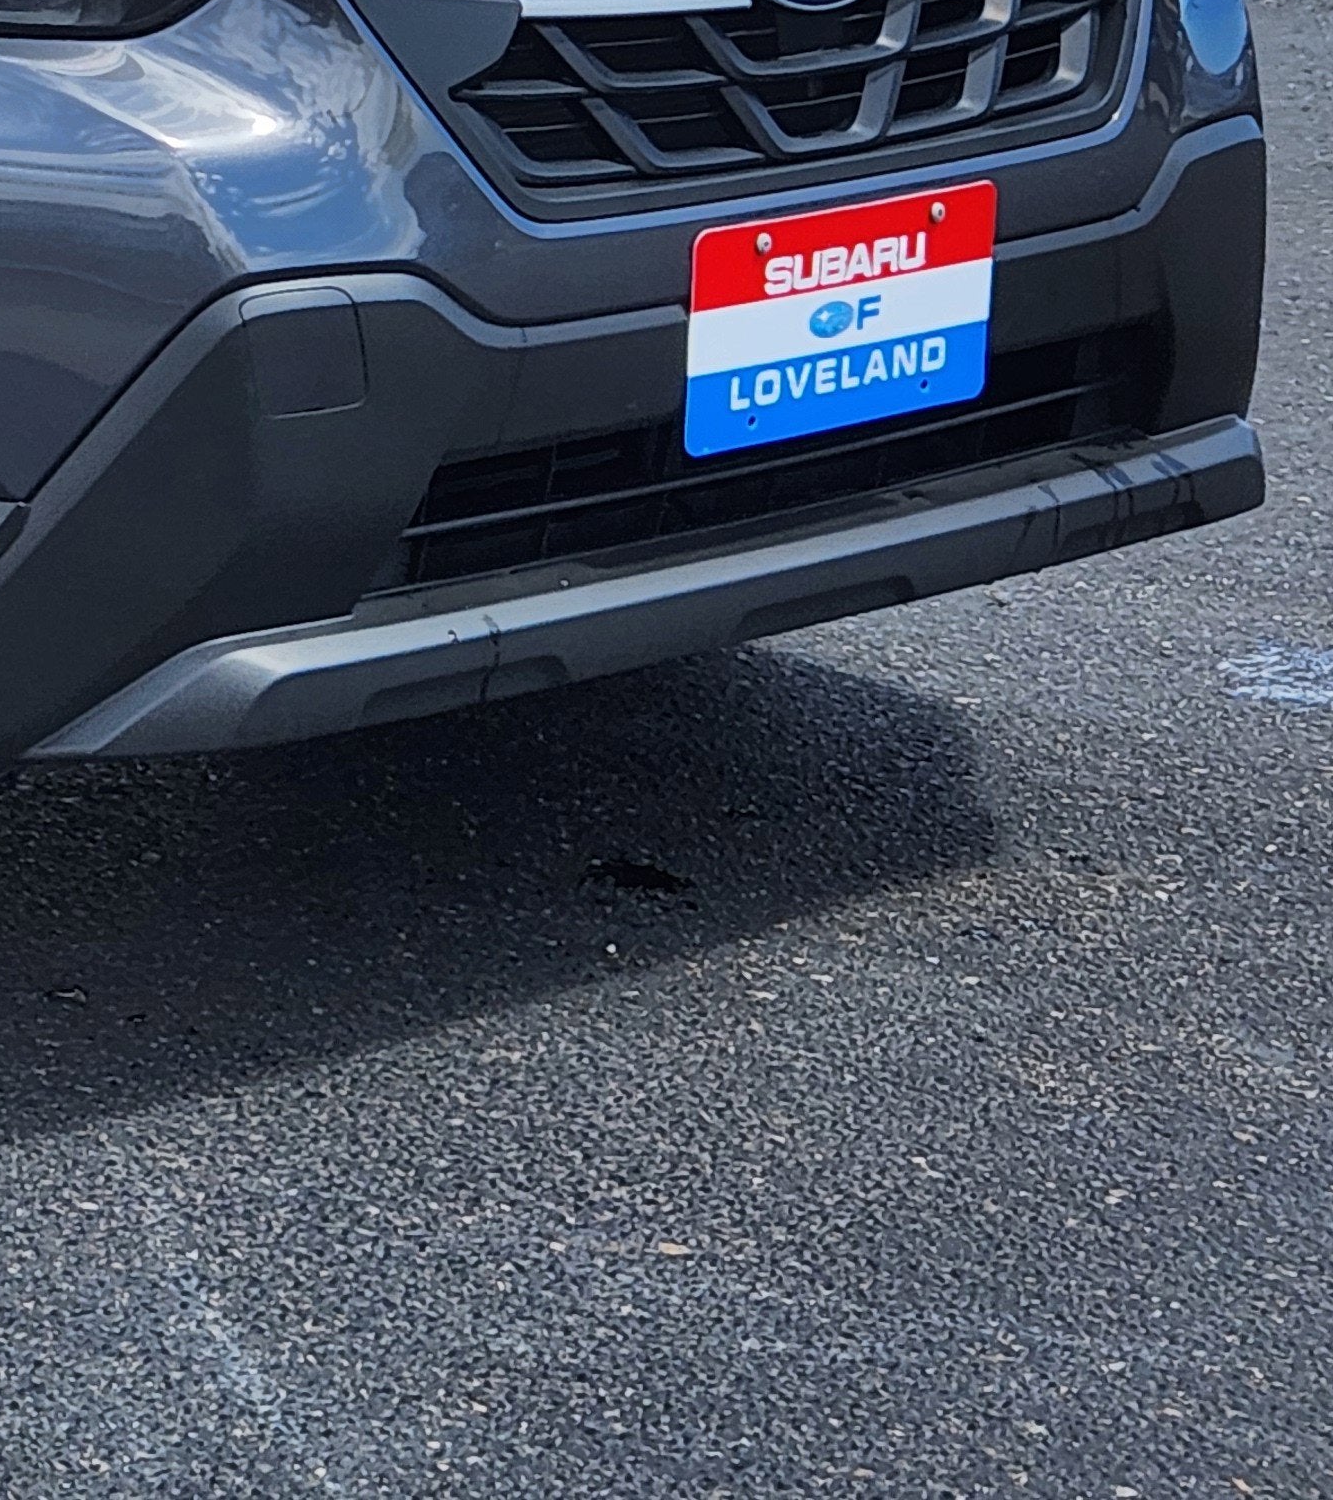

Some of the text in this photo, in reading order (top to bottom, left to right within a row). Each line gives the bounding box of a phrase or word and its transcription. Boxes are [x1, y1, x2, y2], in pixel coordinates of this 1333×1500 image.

[763, 231, 927, 296] SUBARU
[808, 295, 882, 339] OF
[729, 336, 947, 411] LOVELAND
